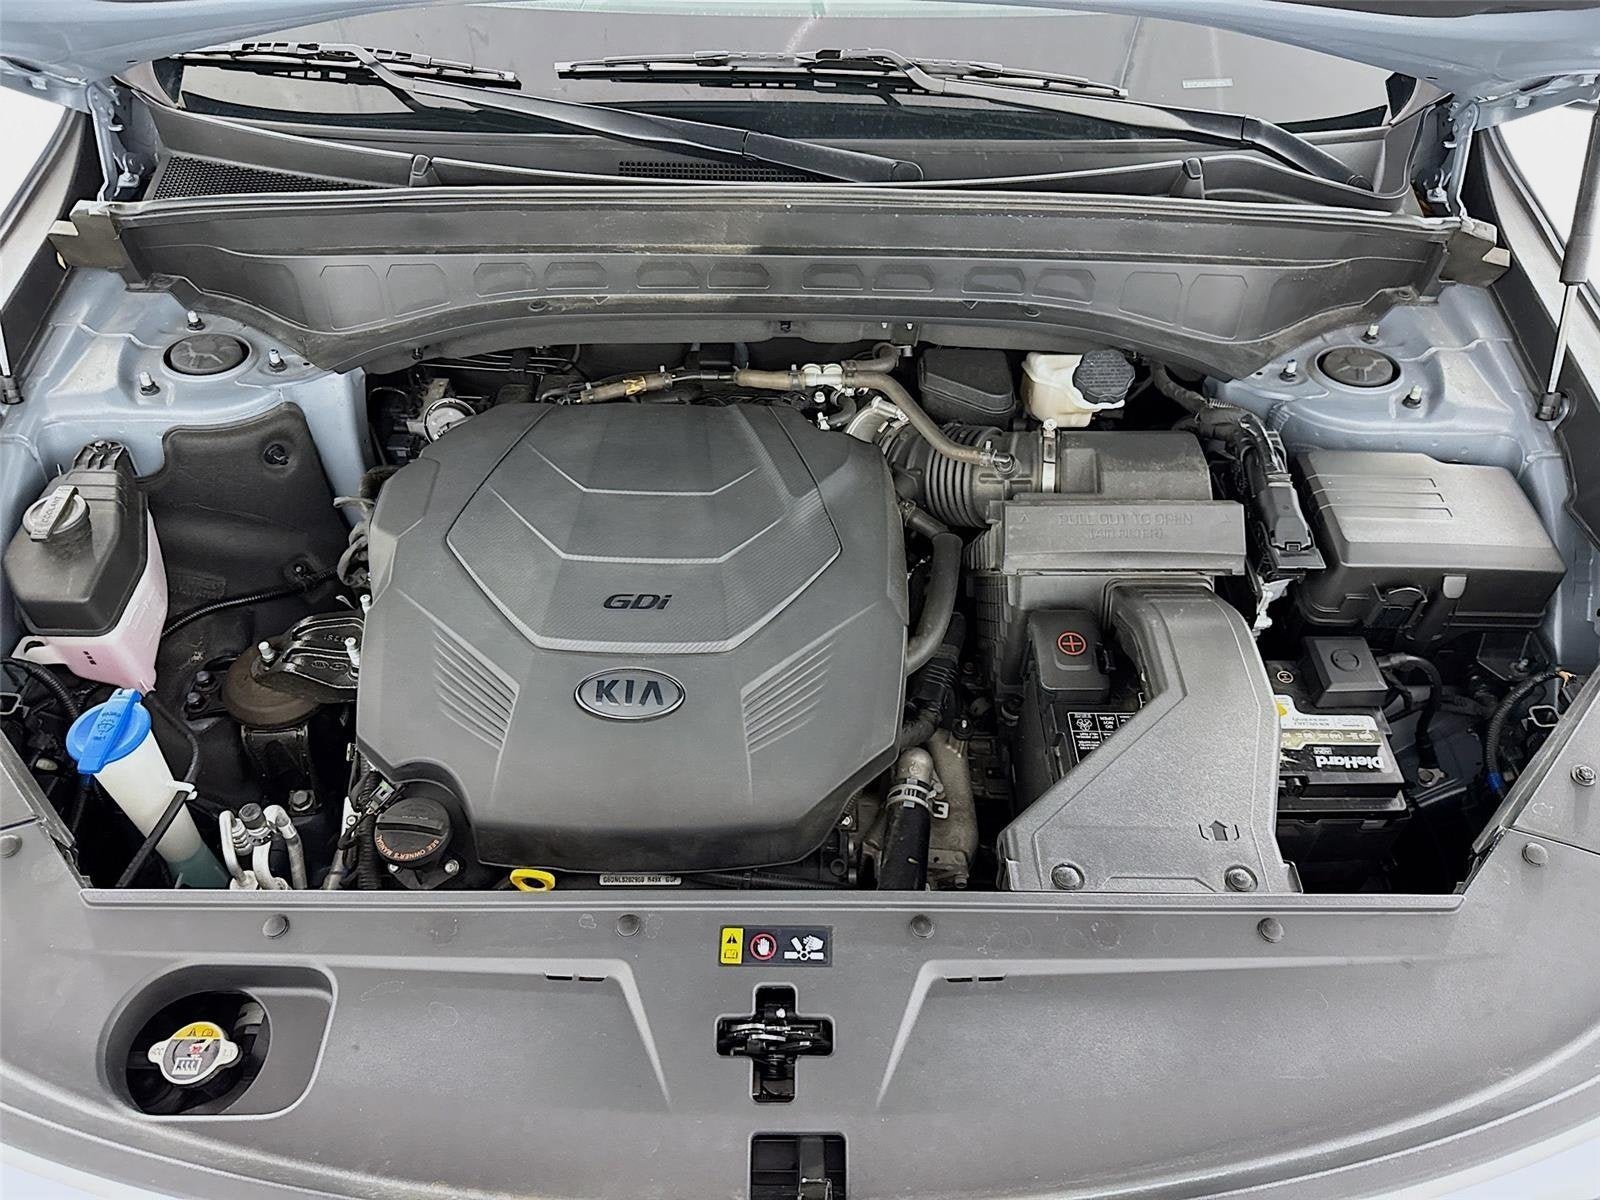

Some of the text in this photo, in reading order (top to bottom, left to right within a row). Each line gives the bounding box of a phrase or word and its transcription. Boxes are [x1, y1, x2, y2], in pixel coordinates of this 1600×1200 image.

[1058, 512, 1193, 526] PULL OUT TO OPEN
[603, 594, 673, 610] GDi
[595, 679, 664, 706] KIA
[1315, 755, 1386, 769] DieHard
